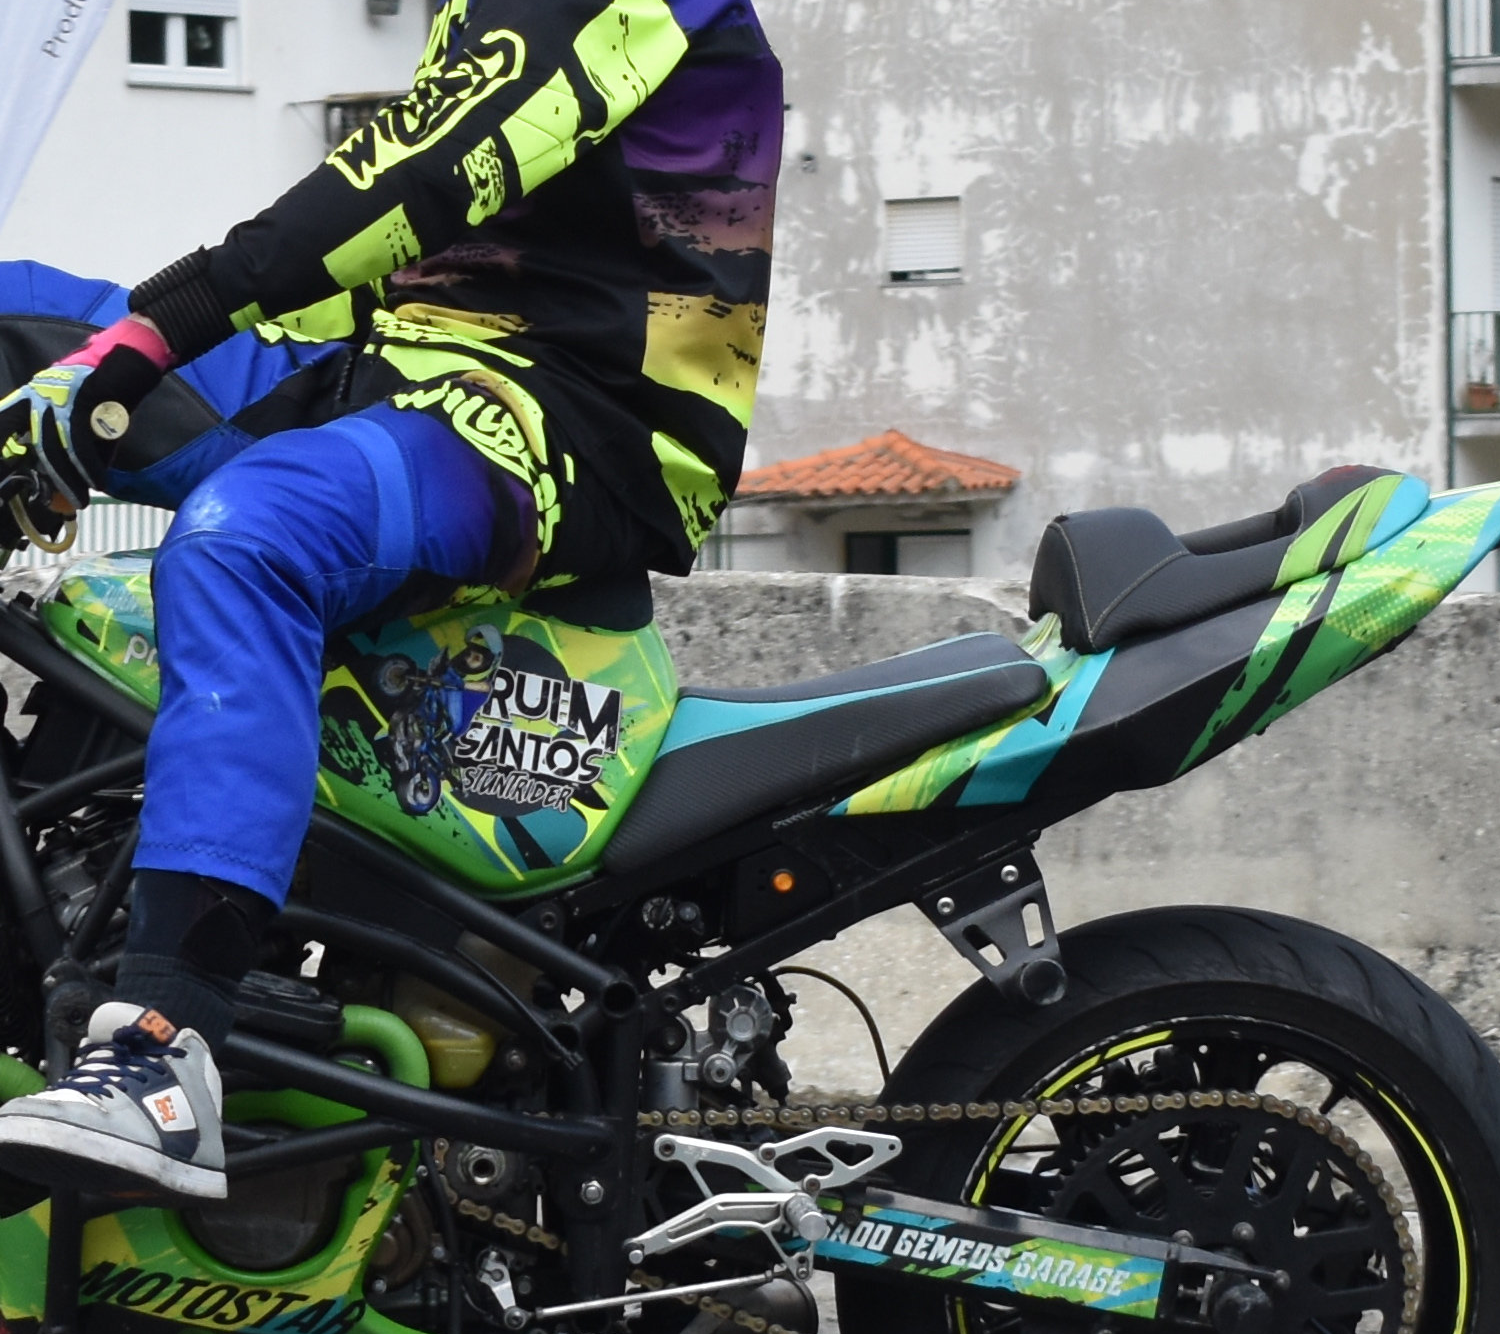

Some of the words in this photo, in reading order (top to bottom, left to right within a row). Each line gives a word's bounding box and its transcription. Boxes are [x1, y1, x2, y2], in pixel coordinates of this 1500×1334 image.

[456, 722, 605, 782] SANTOS
[463, 765, 574, 811] STUNTRIDER
[892, 1228, 1012, 1274] GEMEOS
[1012, 1251, 1131, 1298] GARAGE
